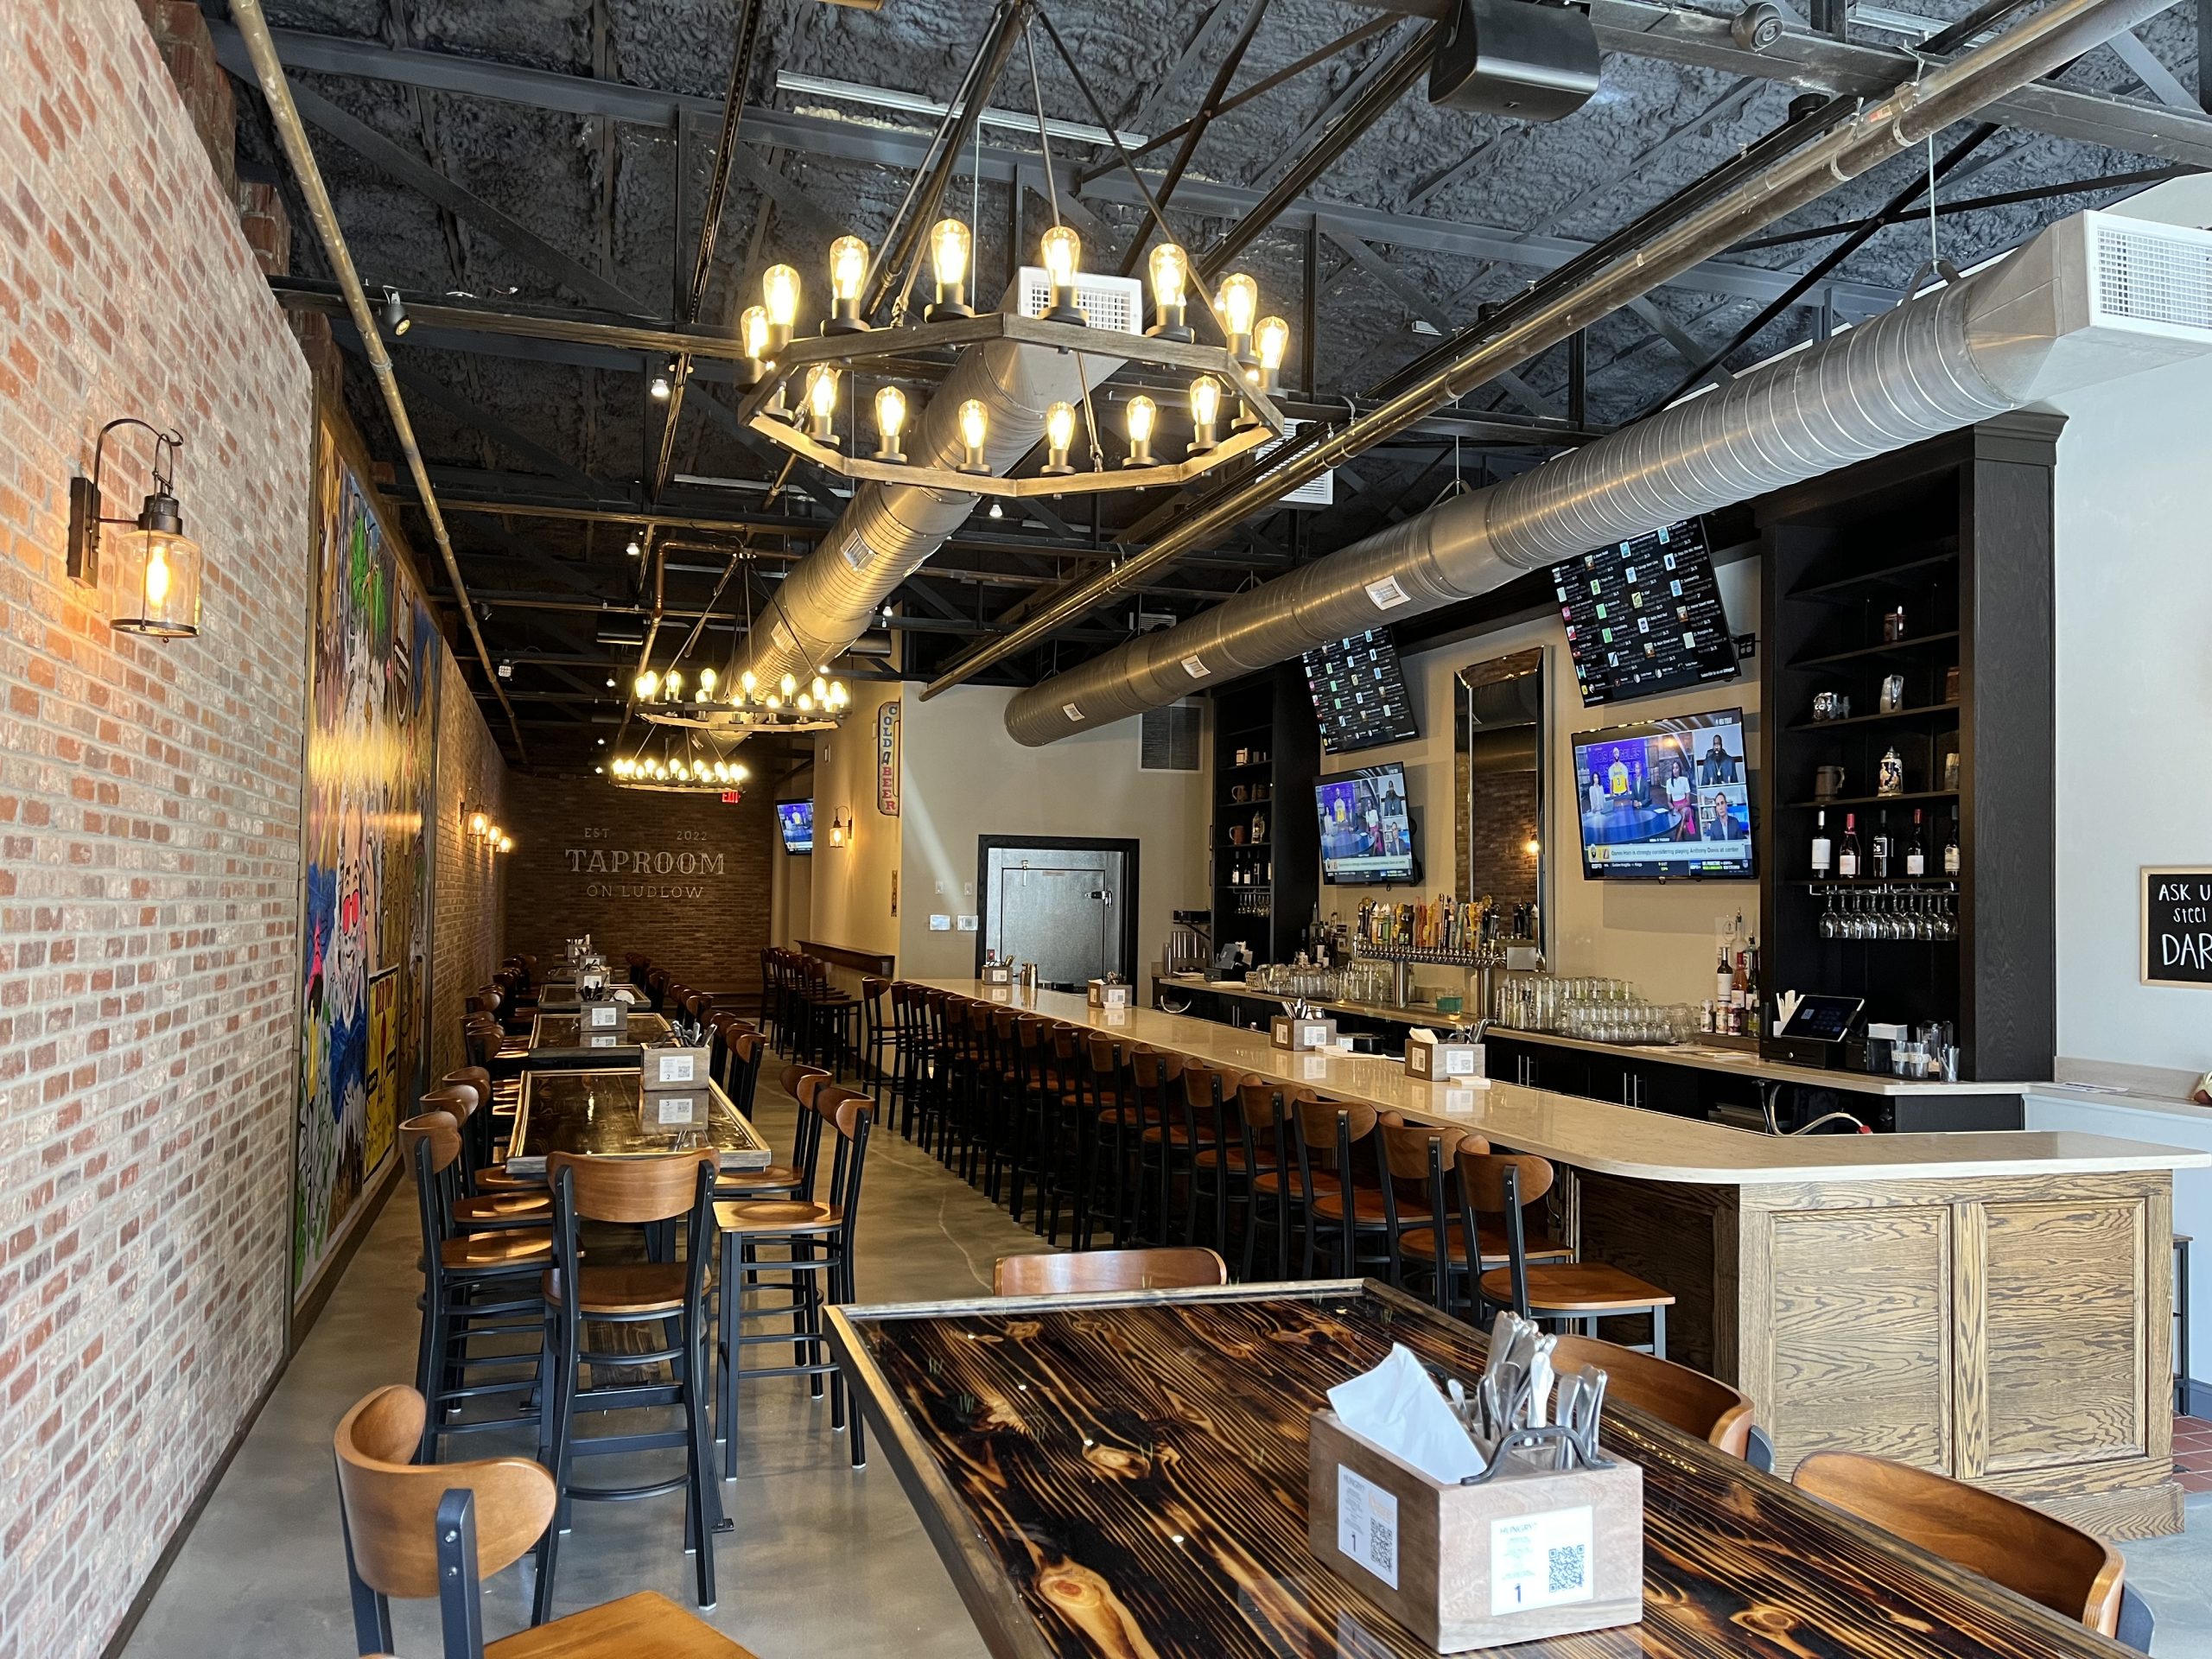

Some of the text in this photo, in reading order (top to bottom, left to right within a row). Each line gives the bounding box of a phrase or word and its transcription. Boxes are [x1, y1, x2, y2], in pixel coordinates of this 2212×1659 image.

[882, 704, 898, 748] COLD
[721, 791, 739, 804] EXIT
[881, 766, 896, 811] BEER
[584, 827, 610, 839] EST
[677, 830, 708, 841] 2022
[565, 849, 725, 875] TAPROOM
[587, 885, 704, 899] ON LUDLOW
[2158, 883, 2191, 902] ASK
[1351, 1534, 1357, 1553] 1
[1514, 1585, 1522, 1604] 1
